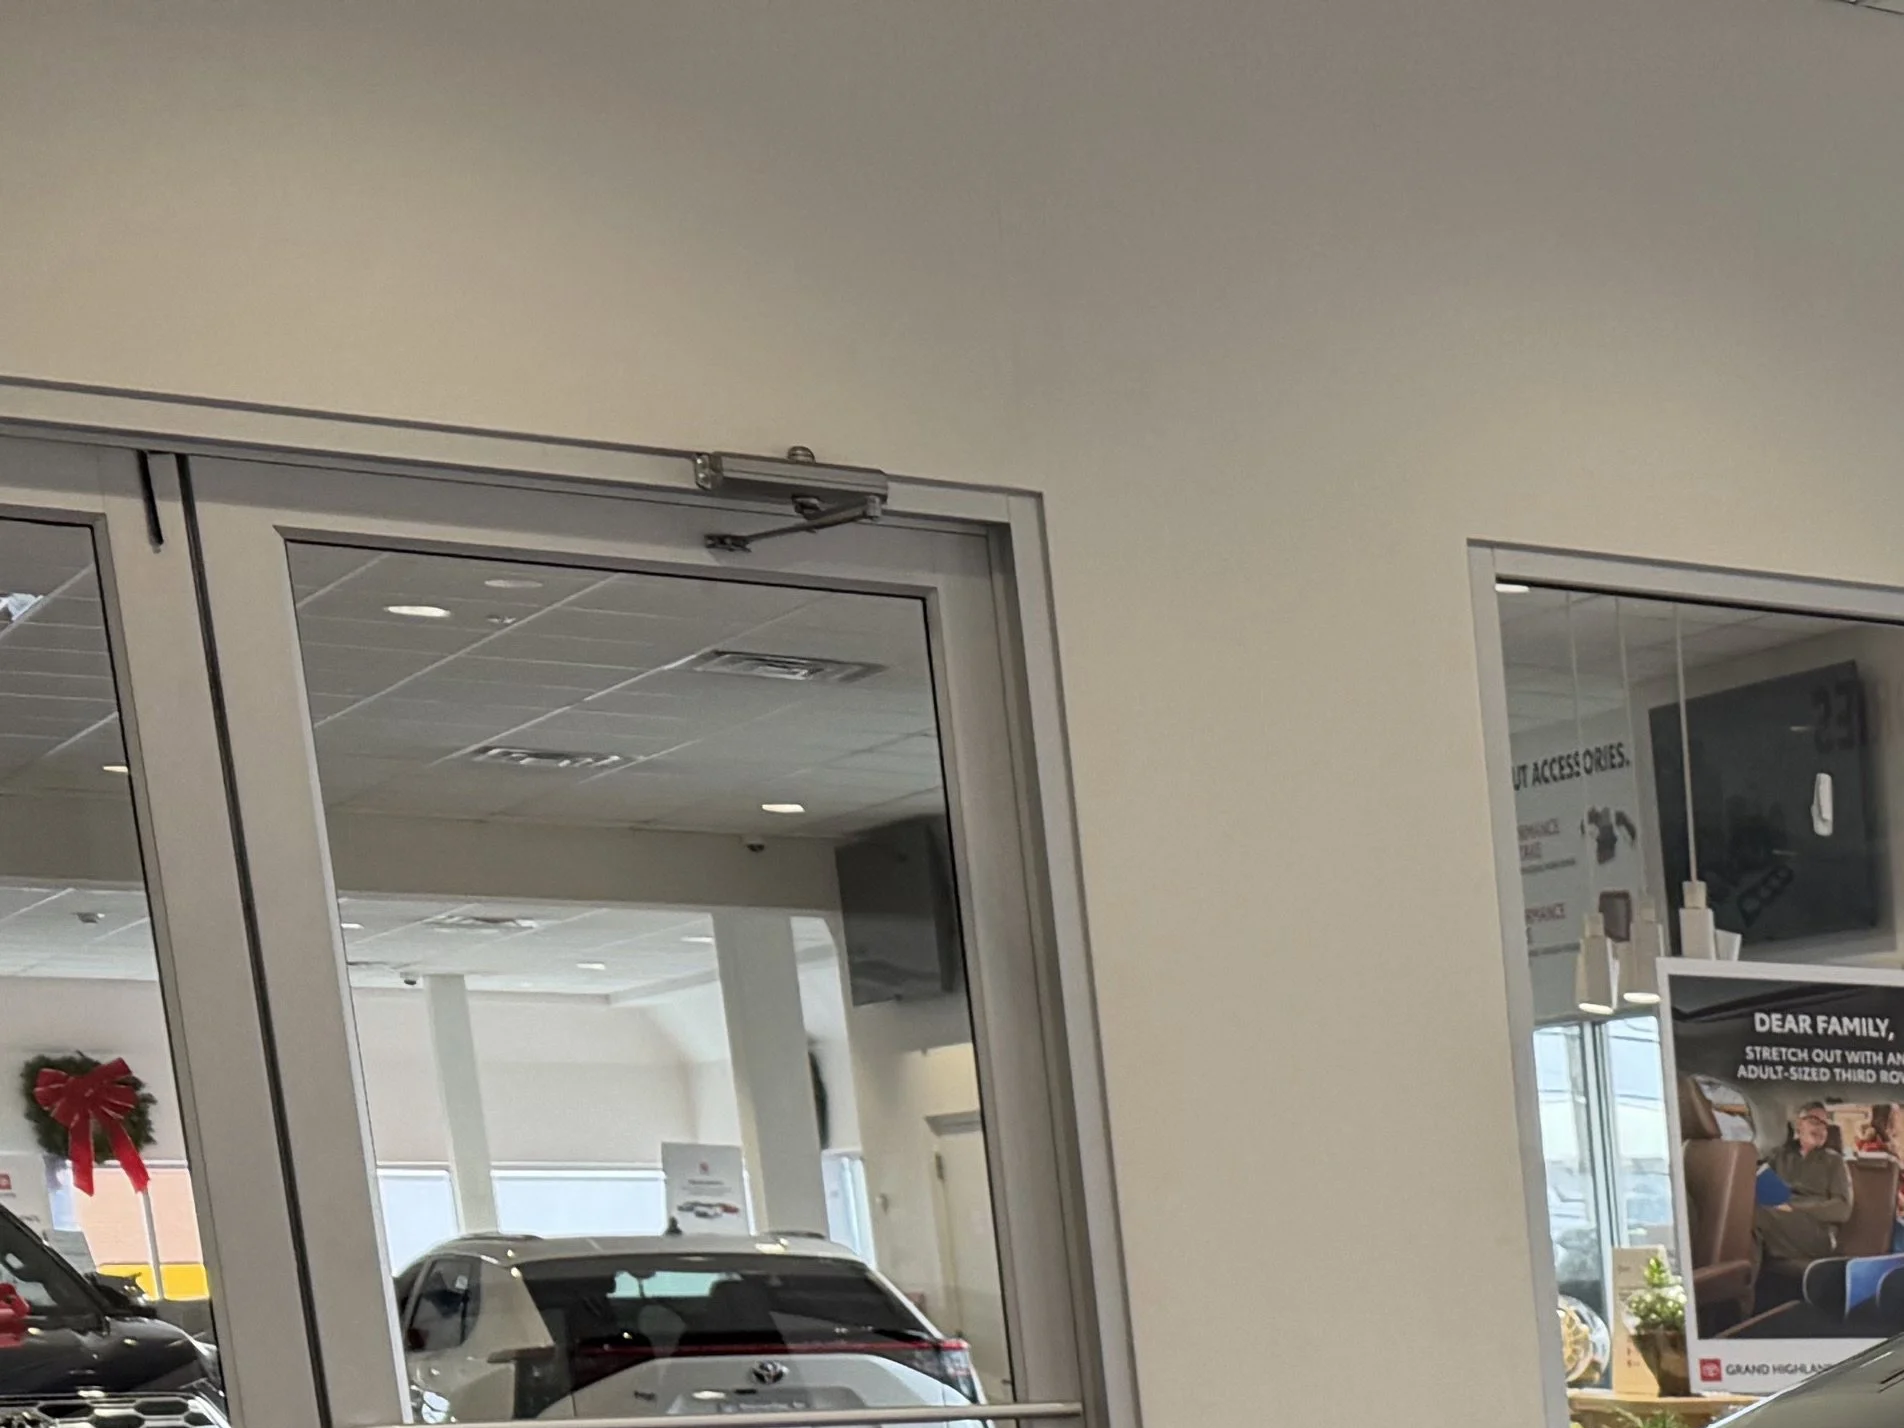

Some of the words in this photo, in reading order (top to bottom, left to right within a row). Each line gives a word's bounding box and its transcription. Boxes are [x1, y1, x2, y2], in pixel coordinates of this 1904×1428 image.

[1754, 1011, 1812, 1035] DEAR
[1816, 1014, 1896, 1041] FAMILY,
[1745, 1046, 1809, 1063] STRETCH
[1813, 1048, 1842, 1064] OUT
[1846, 1050, 1883, 1066] WITH
[1737, 1064, 1831, 1083] ADULT-SIZED
[1834, 1066, 1876, 1084] THIRD
[1725, 1362, 1770, 1376] GRAND
